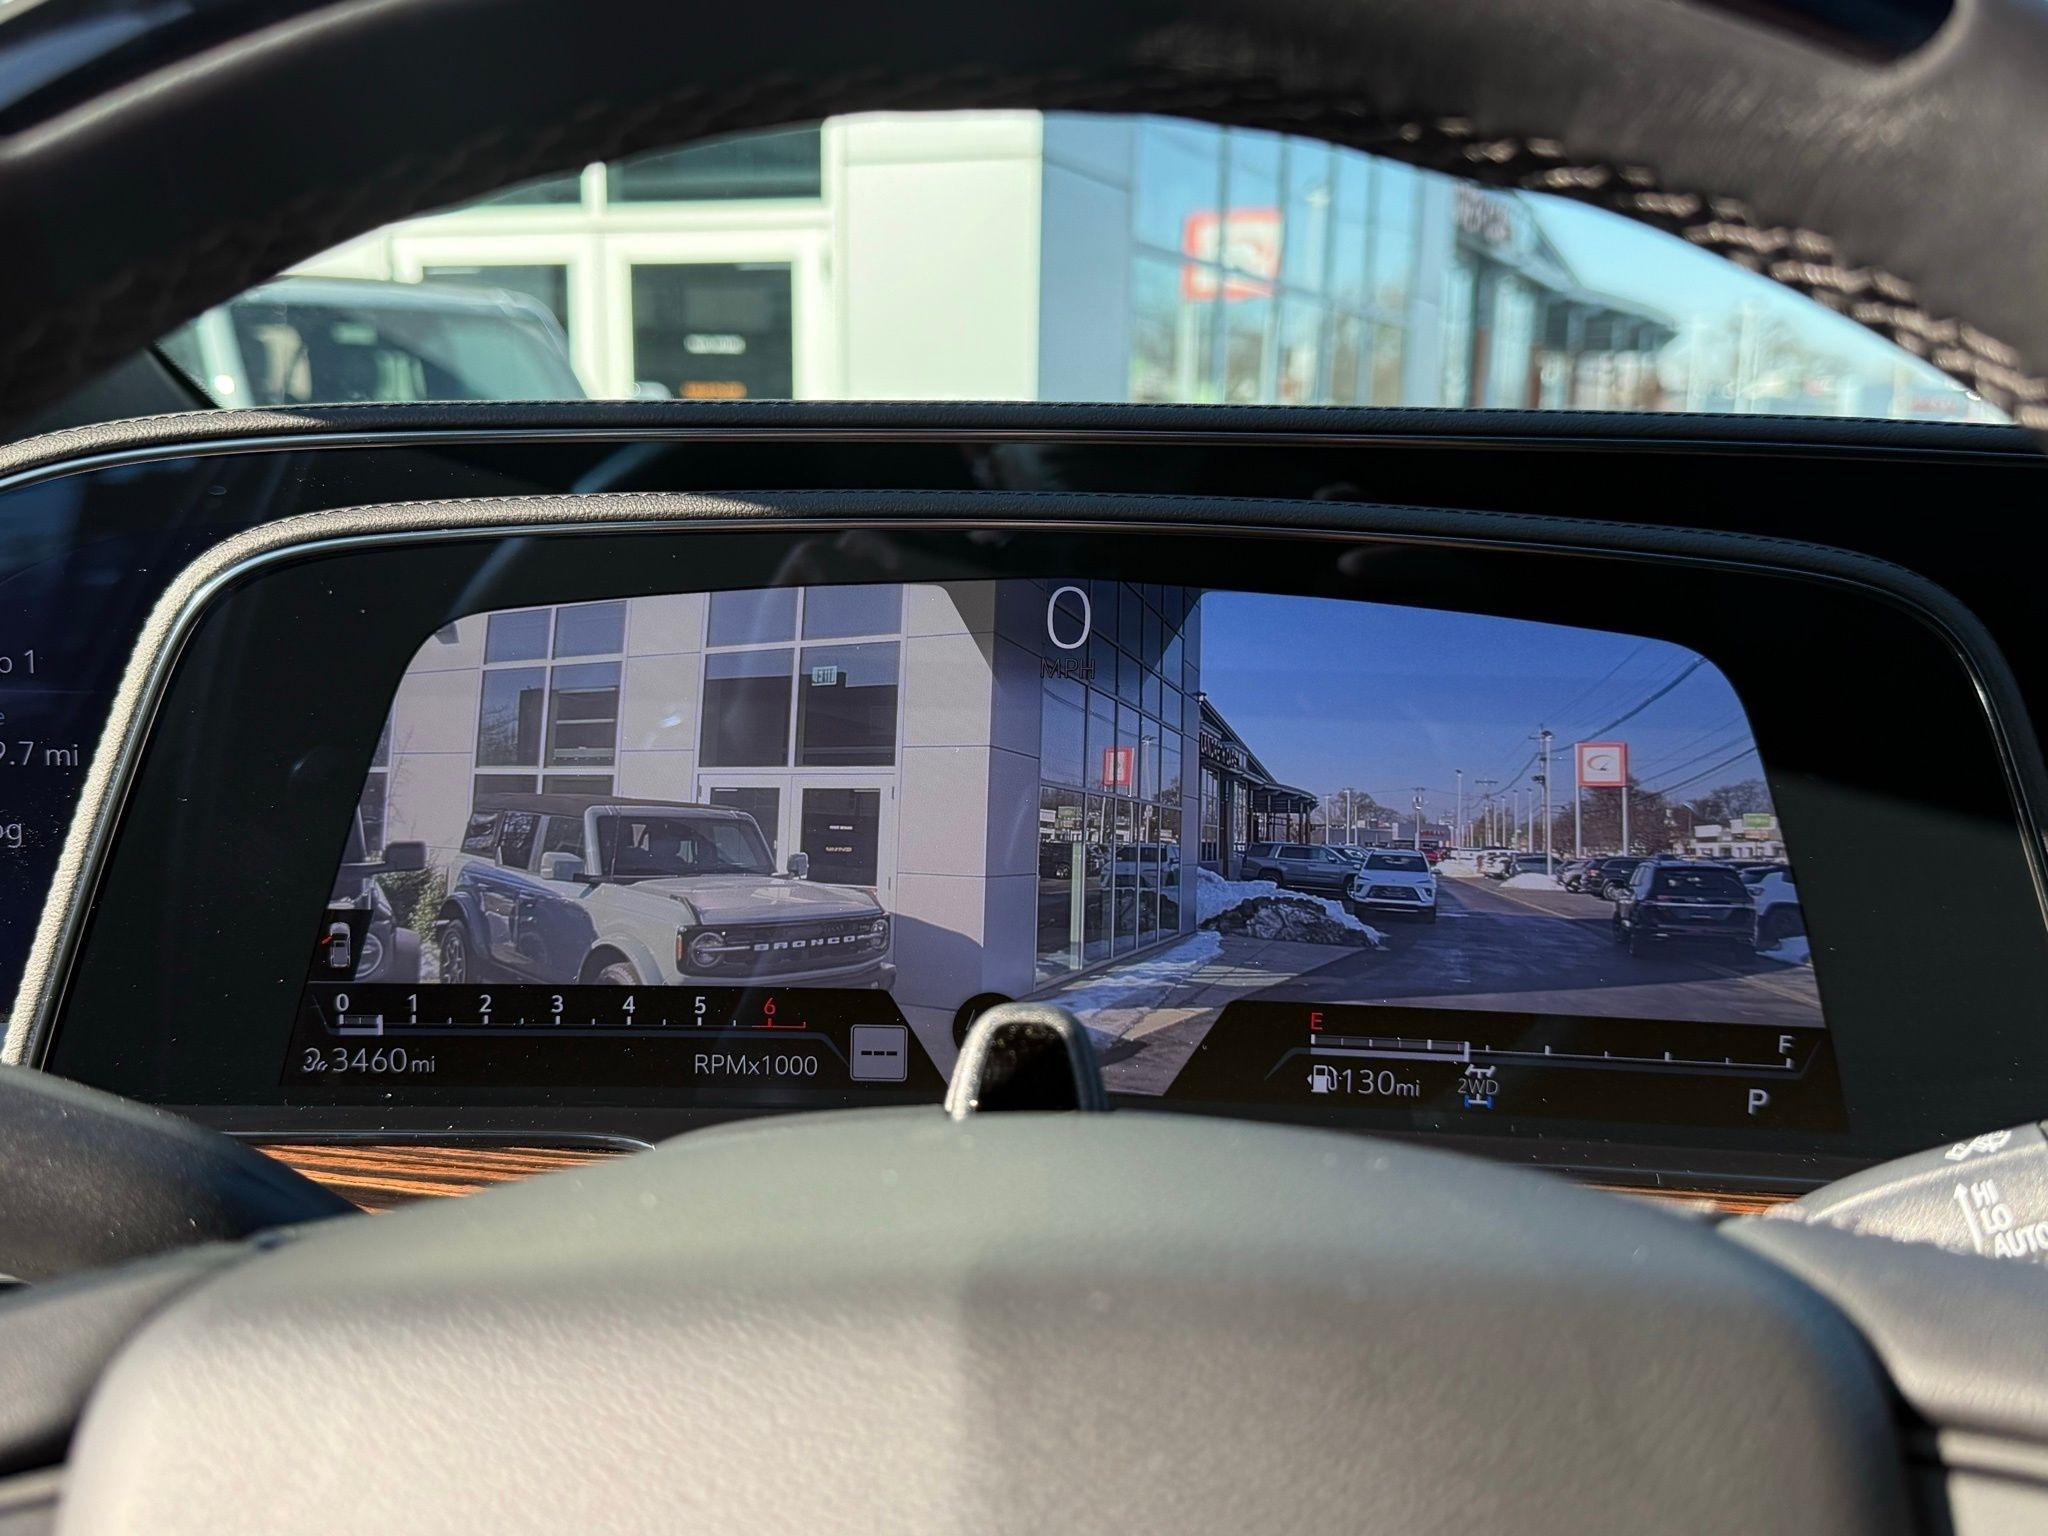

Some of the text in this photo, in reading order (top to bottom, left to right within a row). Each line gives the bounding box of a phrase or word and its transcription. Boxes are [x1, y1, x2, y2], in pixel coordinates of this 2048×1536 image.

[1047, 586, 1091, 649] 0
[24, 649, 35, 674] 1
[1040, 657, 1096, 679] MPH
[45, 743, 79, 766] mi
[335, 993, 776, 1015] 0 1 2 3 4 5 6
[1311, 1012, 1324, 1030] E
[1779, 1034, 1795, 1054] F
[694, 1054, 818, 1076] RPMx1000
[1457, 1078, 1499, 1095] 2WD
[1748, 1088, 1769, 1115] P
[1970, 1179, 1999, 1208] HI
[1980, 1203, 2013, 1234] LO
[1994, 1221, 2048, 1259] AUTO
